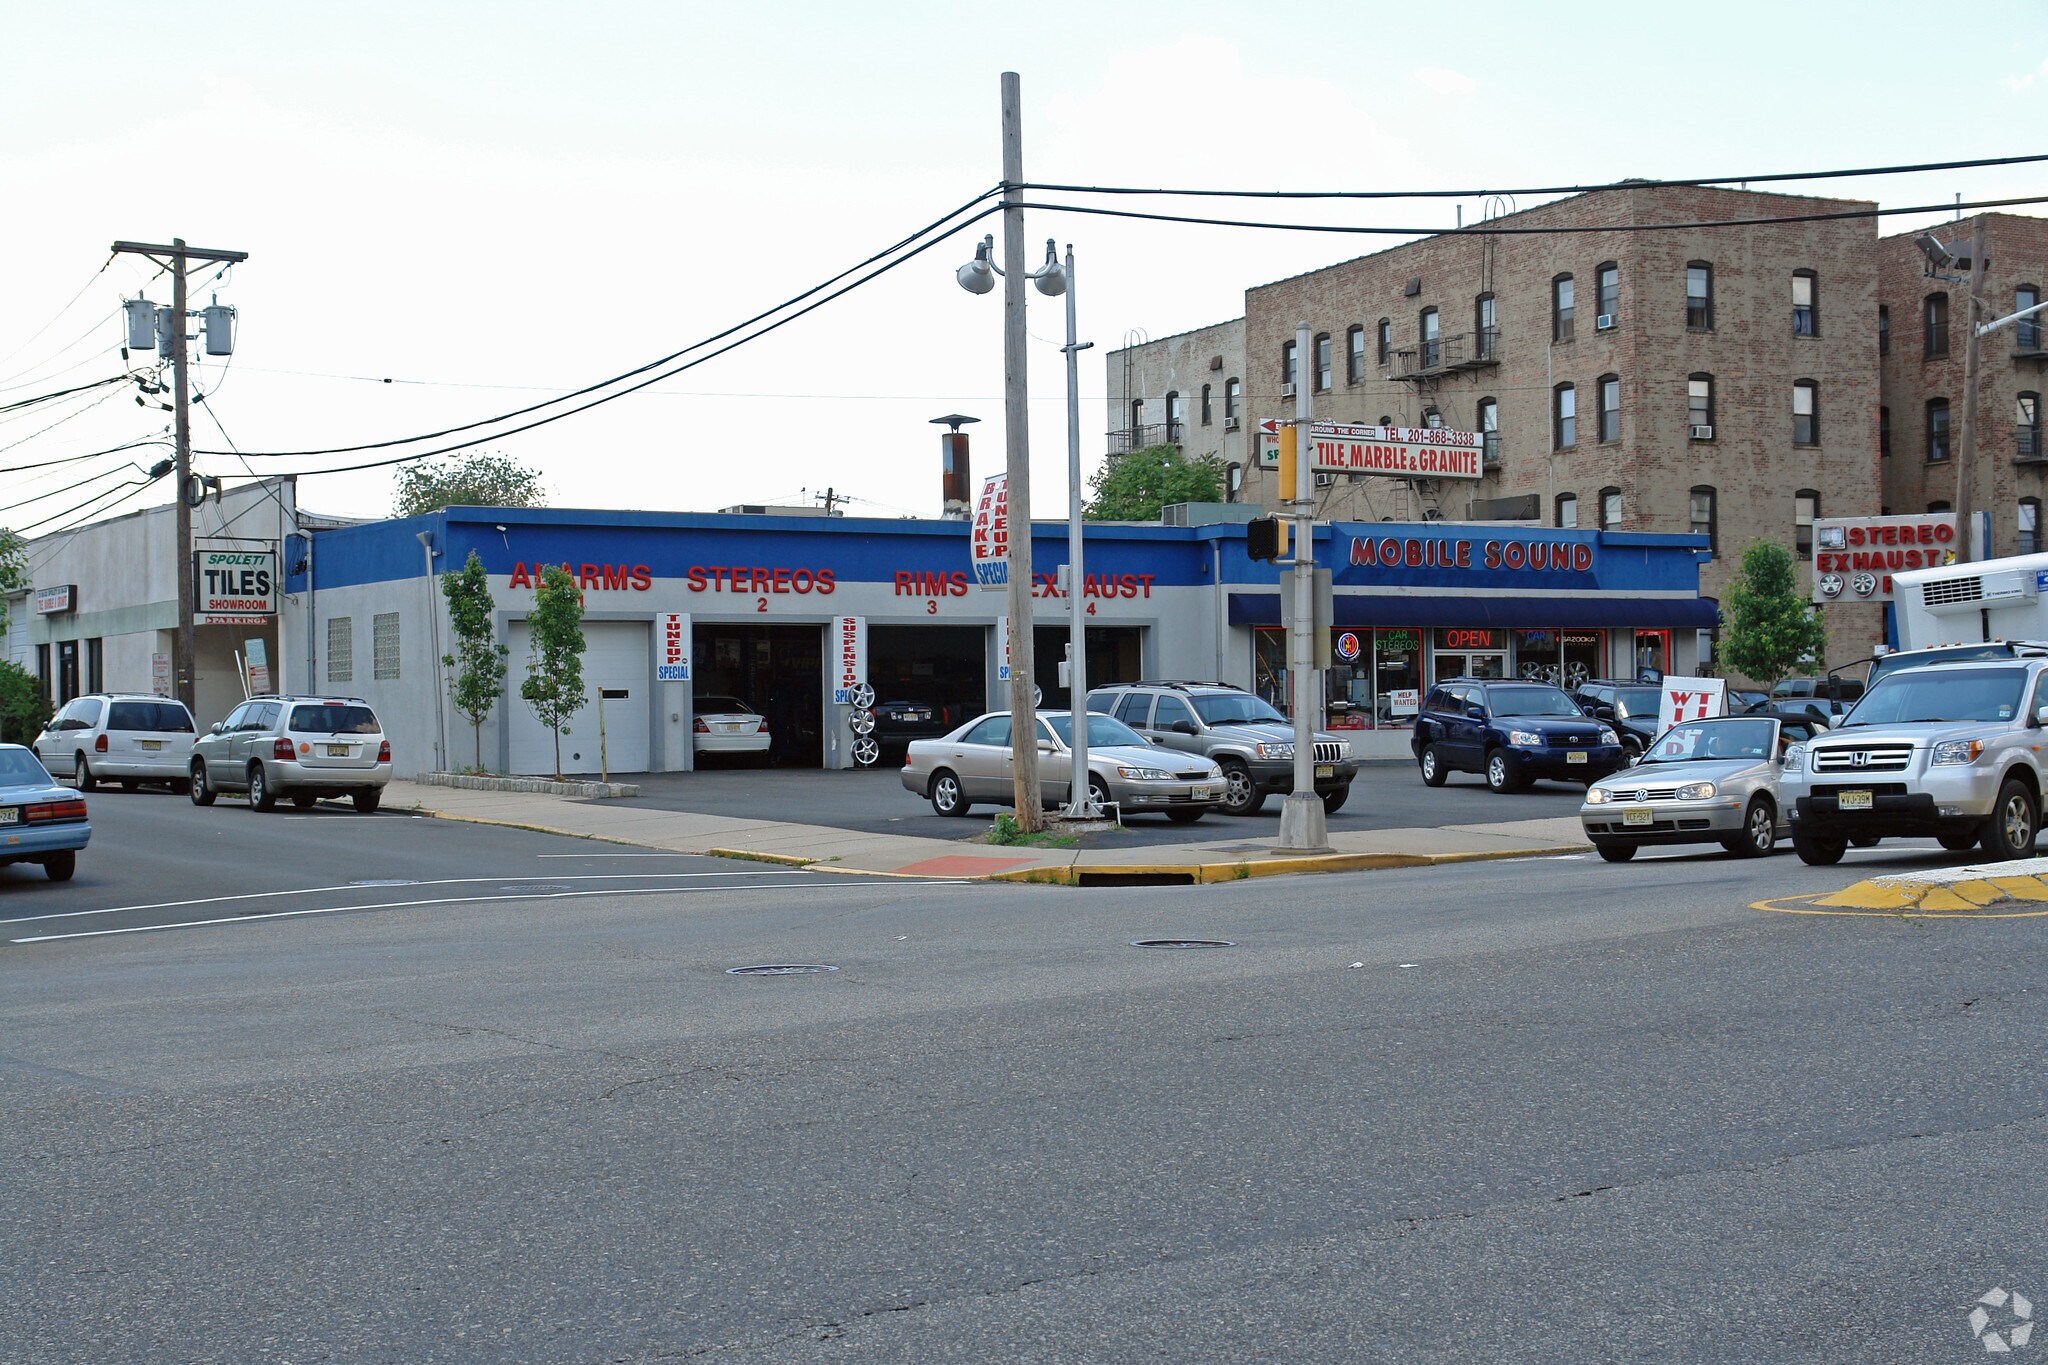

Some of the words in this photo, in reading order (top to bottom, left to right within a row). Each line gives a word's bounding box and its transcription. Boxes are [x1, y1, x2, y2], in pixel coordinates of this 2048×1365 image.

[1311, 425, 1335, 434] AROUND
[1351, 428, 1375, 436] CORNER
[1384, 427, 1404, 441] TEL.
[1408, 428, 1475, 446] 201-868-3338
[1419, 448, 1478, 474] GRANITE
[974, 482, 996, 559] BRAKE
[1849, 523, 1953, 546] STEREO
[208, 554, 266, 566] SPOLETI
[1350, 537, 1472, 567] MOBILE
[1484, 540, 1593, 571] SOUND
[1817, 549, 1940, 573] EXHAUST
[204, 569, 271, 597] TILES
[687, 565, 836, 595] STEREOS
[894, 571, 968, 597] RIMS
[209, 599, 267, 610] SHOWROOM
[757, 597, 768, 612] 2
[927, 600, 938, 615] 3
[1085, 602, 1097, 616] 4
[212, 616, 261, 625] PARKING
[666, 614, 681, 664] TUNEUP
[1388, 630, 1408, 640] CAR
[1447, 630, 1491, 647] OPEN
[1526, 630, 1546, 641] CAR
[842, 617, 856, 689] SUSPENSION
[1376, 639, 1419, 651] STEREOS
[658, 665, 689, 680] SPECIAL
[1397, 691, 1412, 699] HELP
